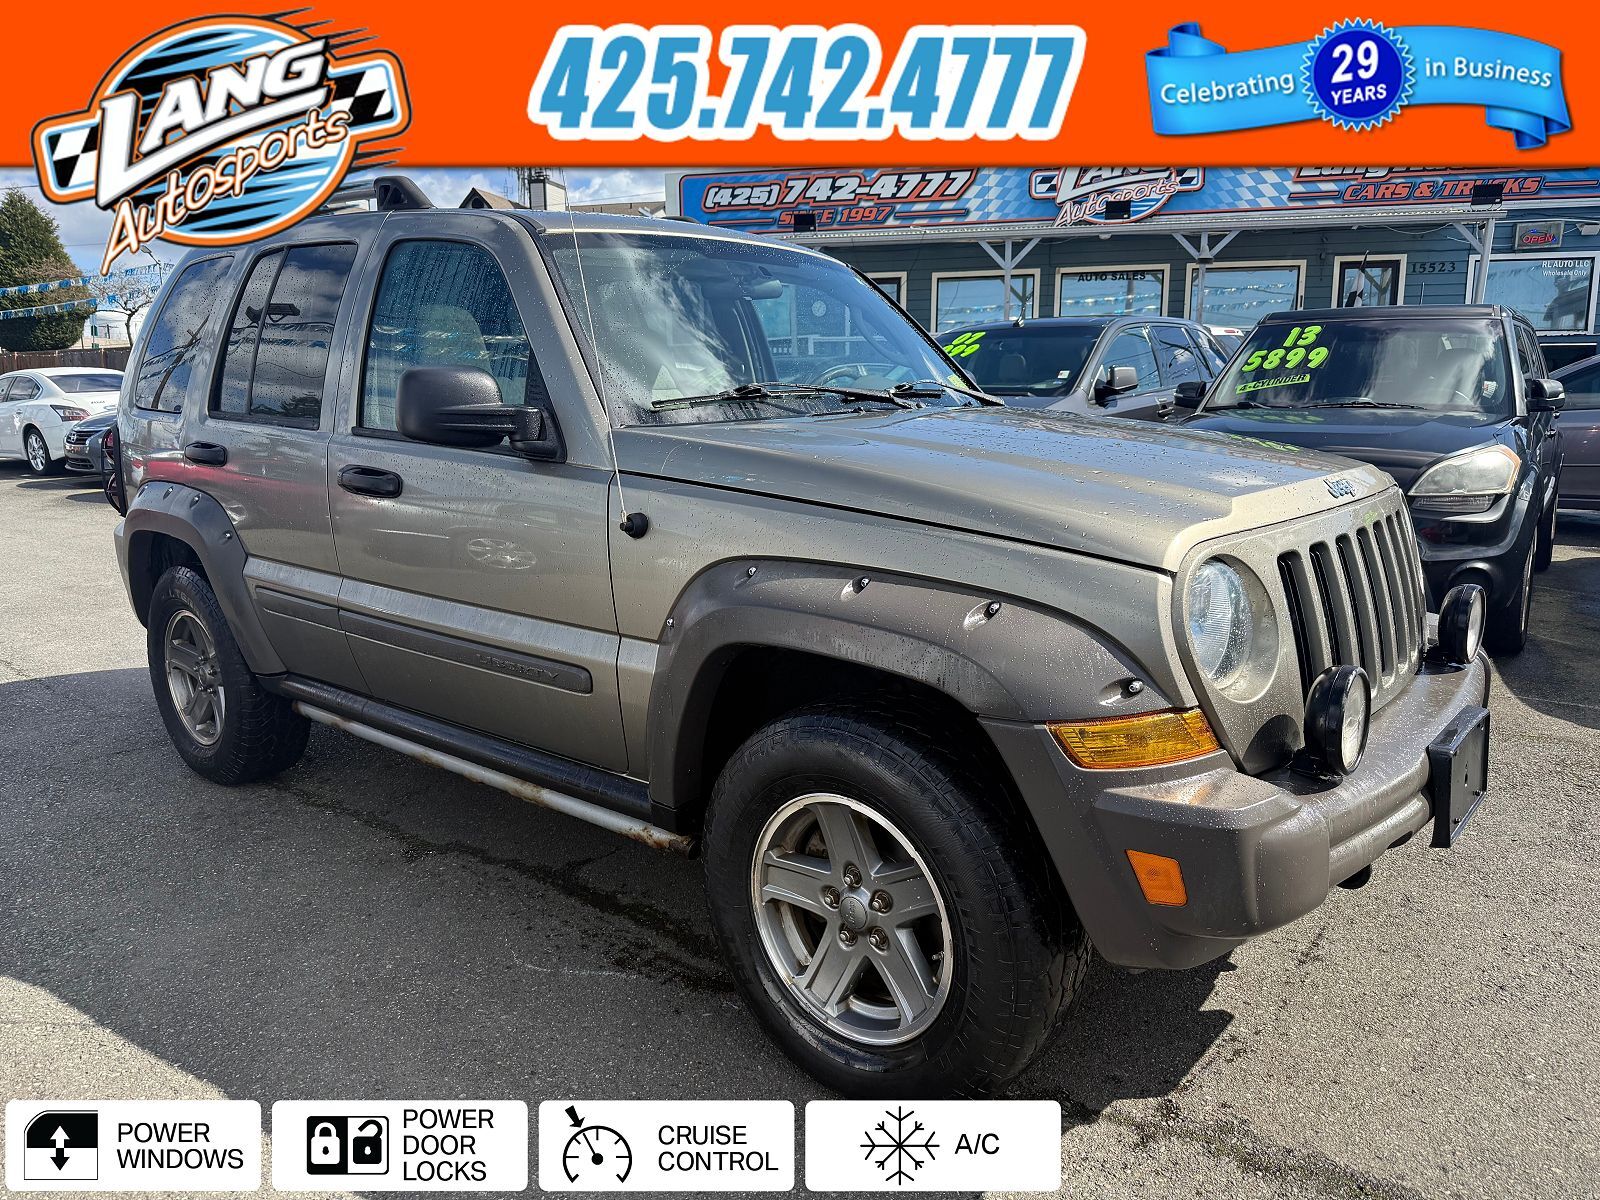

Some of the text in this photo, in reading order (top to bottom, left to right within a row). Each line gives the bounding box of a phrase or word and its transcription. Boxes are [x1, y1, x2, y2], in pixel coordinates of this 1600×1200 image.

[704, 171, 972, 208] (425) 742-4777
[1344, 177, 1541, 200] CARS & TRKS
[841, 206, 892, 222] 1997
[1522, 232, 1555, 245] OPEN
[1411, 262, 1456, 273] 15523
[1552, 260, 1574, 268] AUTO
[1575, 259, 1590, 268] LLC
[1077, 271, 1147, 283] AUTO SALES
[1283, 325, 1323, 348] 13
[1241, 346, 1330, 372] 5899
